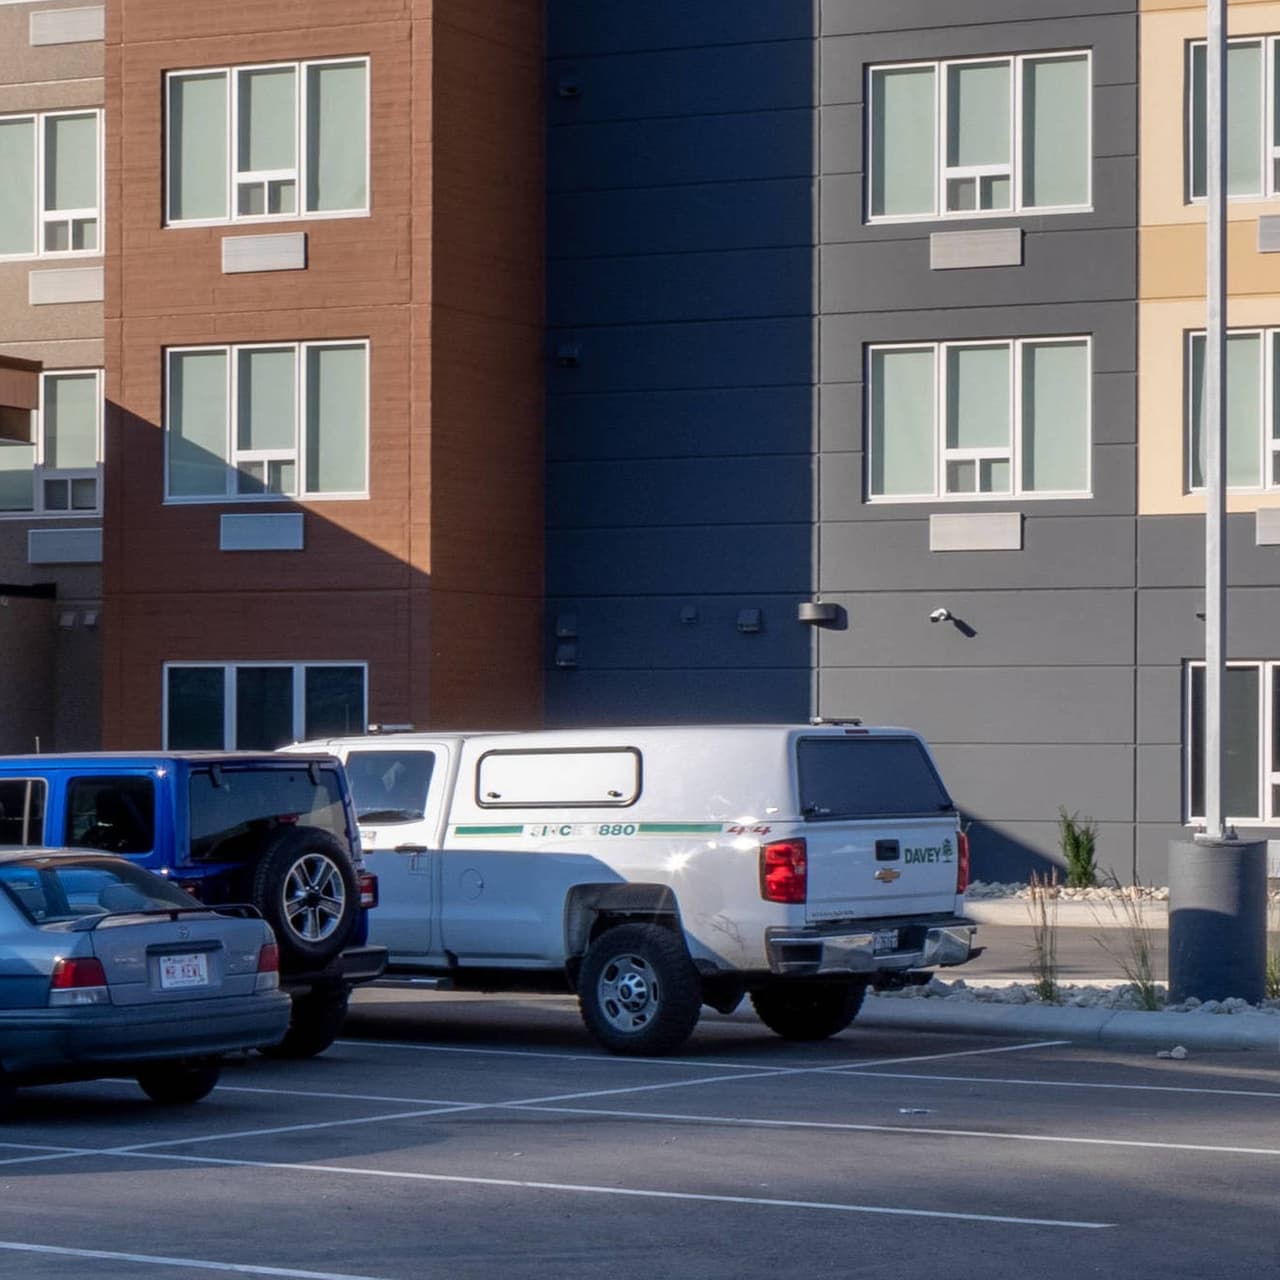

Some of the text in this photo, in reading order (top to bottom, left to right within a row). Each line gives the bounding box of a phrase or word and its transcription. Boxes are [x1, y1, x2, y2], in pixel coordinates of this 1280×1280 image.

[530, 825, 636, 836] SIC 880
[726, 826, 772, 836] 44
[904, 848, 942, 864] DAVEY
